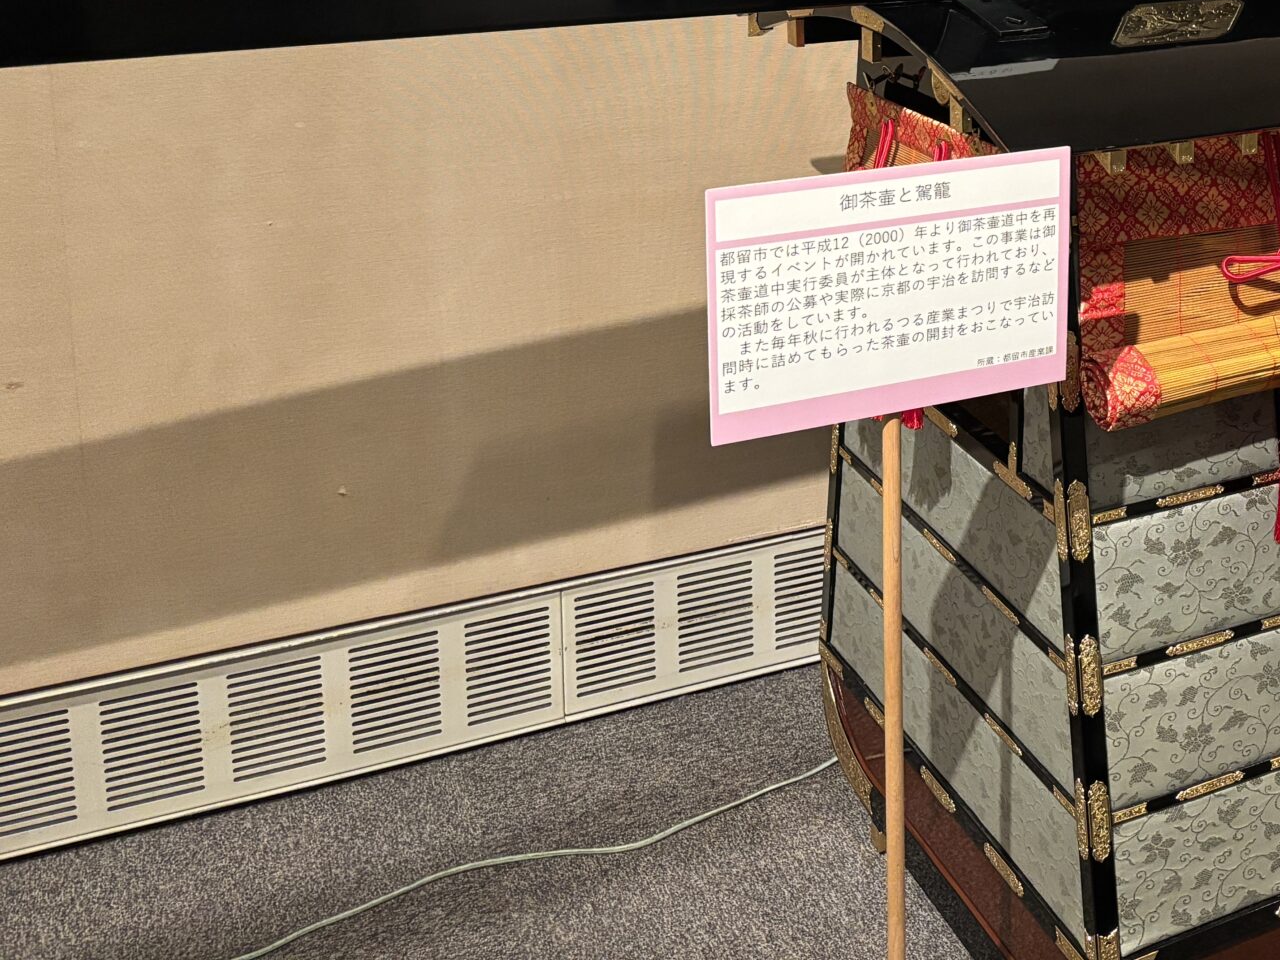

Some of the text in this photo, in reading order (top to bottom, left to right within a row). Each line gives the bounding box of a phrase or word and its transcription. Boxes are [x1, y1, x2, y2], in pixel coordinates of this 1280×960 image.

[720, 224, 1056, 285] 現するイベントが開かれています。この事業は御
[720, 258, 1055, 322] 採茶師の公募や実際に京都の宇治を訪問するなど
[722, 305, 868, 339] の活動をしています。
[739, 291, 1055, 355] また毎年秋に行われるつる産業まつりで宇治訪
[723, 376, 761, 394] ます。
